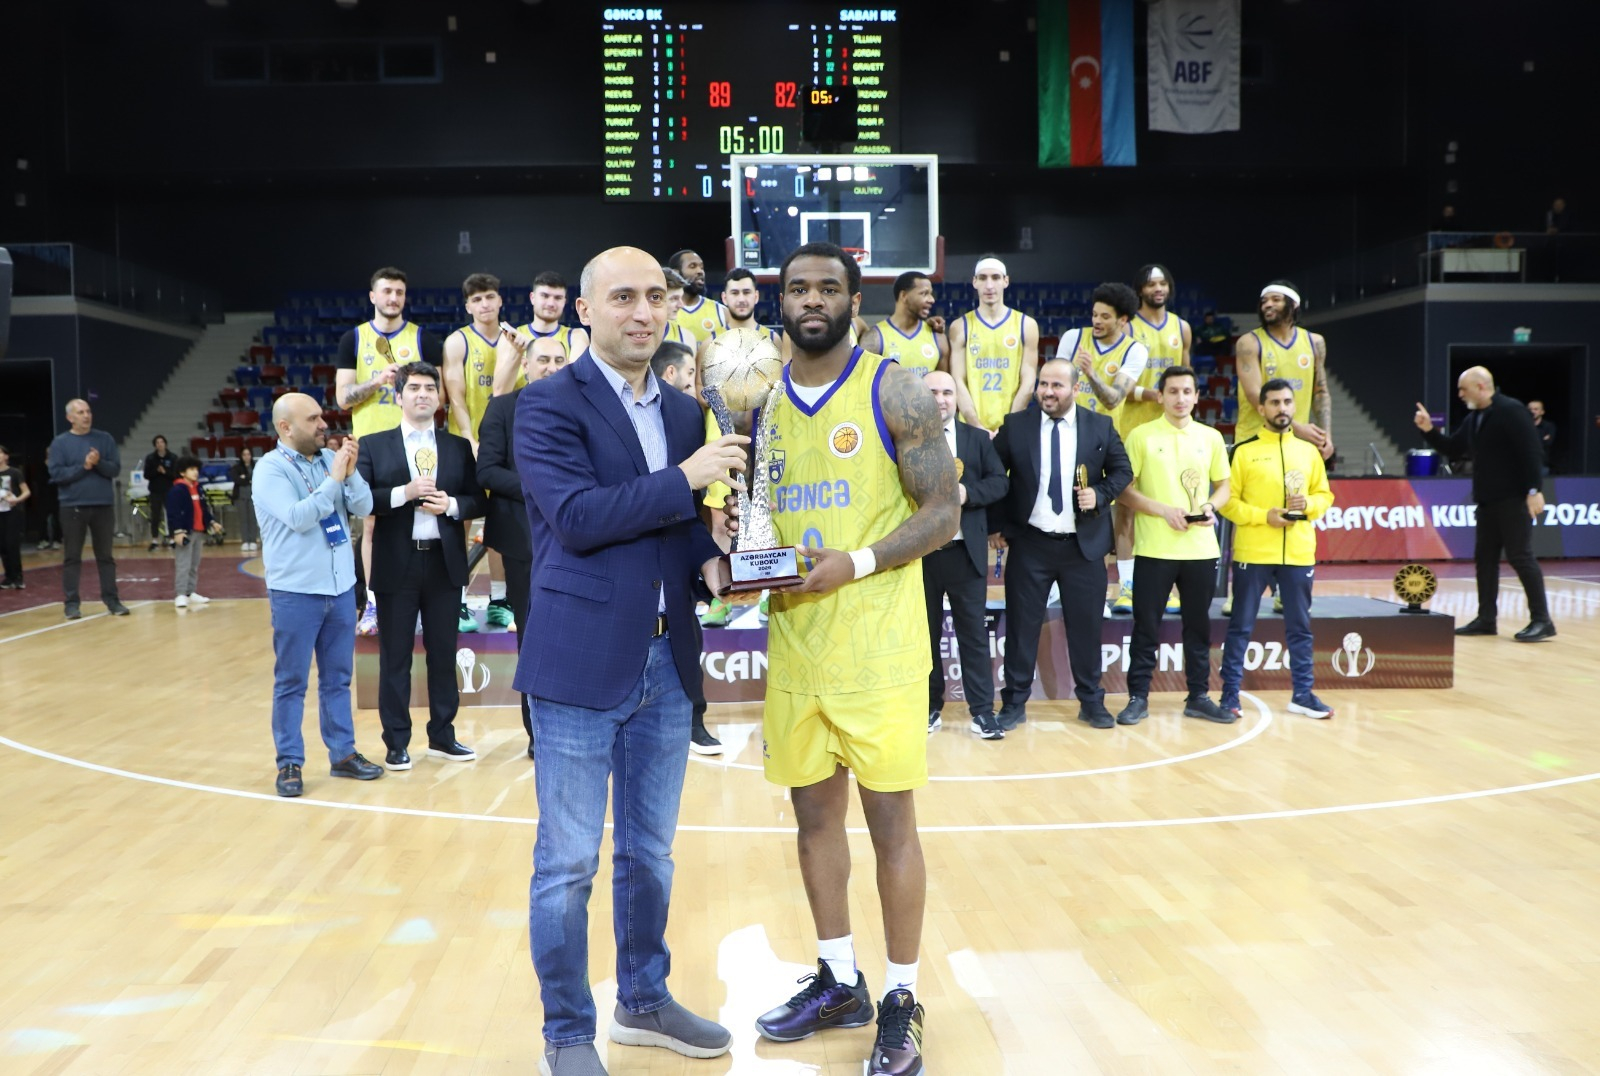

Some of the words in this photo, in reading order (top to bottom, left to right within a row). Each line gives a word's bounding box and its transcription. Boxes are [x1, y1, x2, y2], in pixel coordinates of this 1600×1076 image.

[646, 9, 662, 20] BK
[840, 10, 878, 21] SABAH
[879, 10, 896, 21] BK
[653, 62, 659, 72] 2
[1174, 61, 1213, 83] ABF
[709, 81, 731, 108] 89
[775, 81, 796, 108] 82
[720, 126, 784, 154] 05:00
[703, 175, 712, 198] 0
[795, 175, 804, 198] 0
[982, 372, 1003, 391] 22
[776, 479, 851, 514] GƏNCƏ
[1542, 502, 1600, 526] 2026
[740, 551, 787, 561] AZƏRBAYCAN
[749, 559, 779, 567] KUBOKU
[699, 650, 769, 683] CAN
